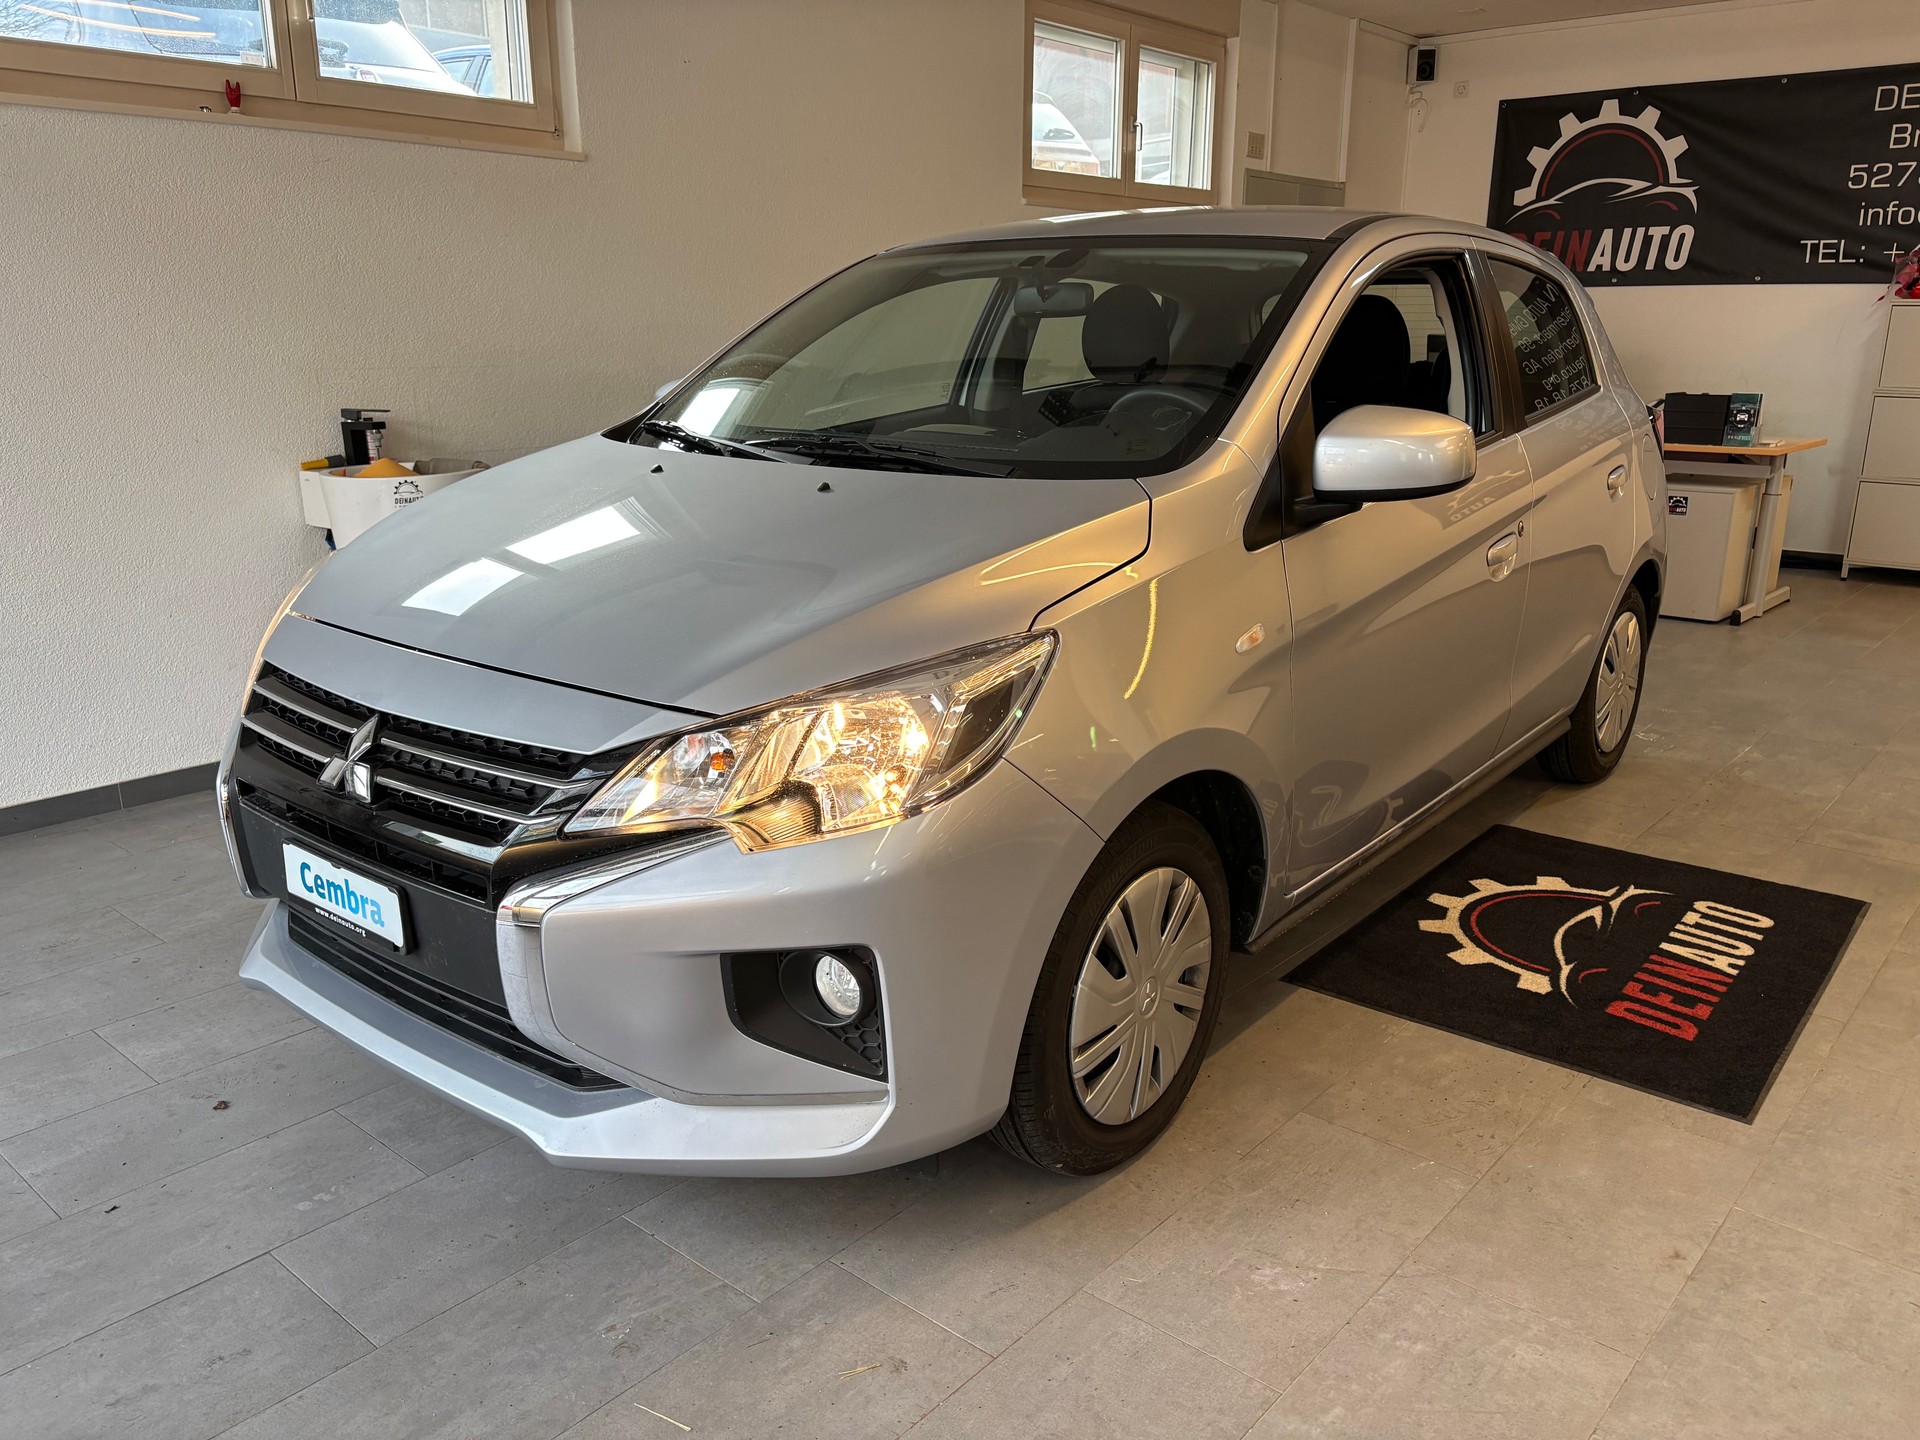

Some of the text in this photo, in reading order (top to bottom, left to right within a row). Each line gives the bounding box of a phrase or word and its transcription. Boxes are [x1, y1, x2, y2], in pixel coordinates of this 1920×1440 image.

[1873, 82, 1920, 112] DE
[1847, 161, 1920, 190] 527
[1858, 200, 1920, 227] info
[1799, 239, 1867, 265] TEL:
[299, 861, 386, 928] Cembra
[314, 906, 367, 938] www.deinauto.org
[1604, 899, 1776, 1042] DEINAUTO
